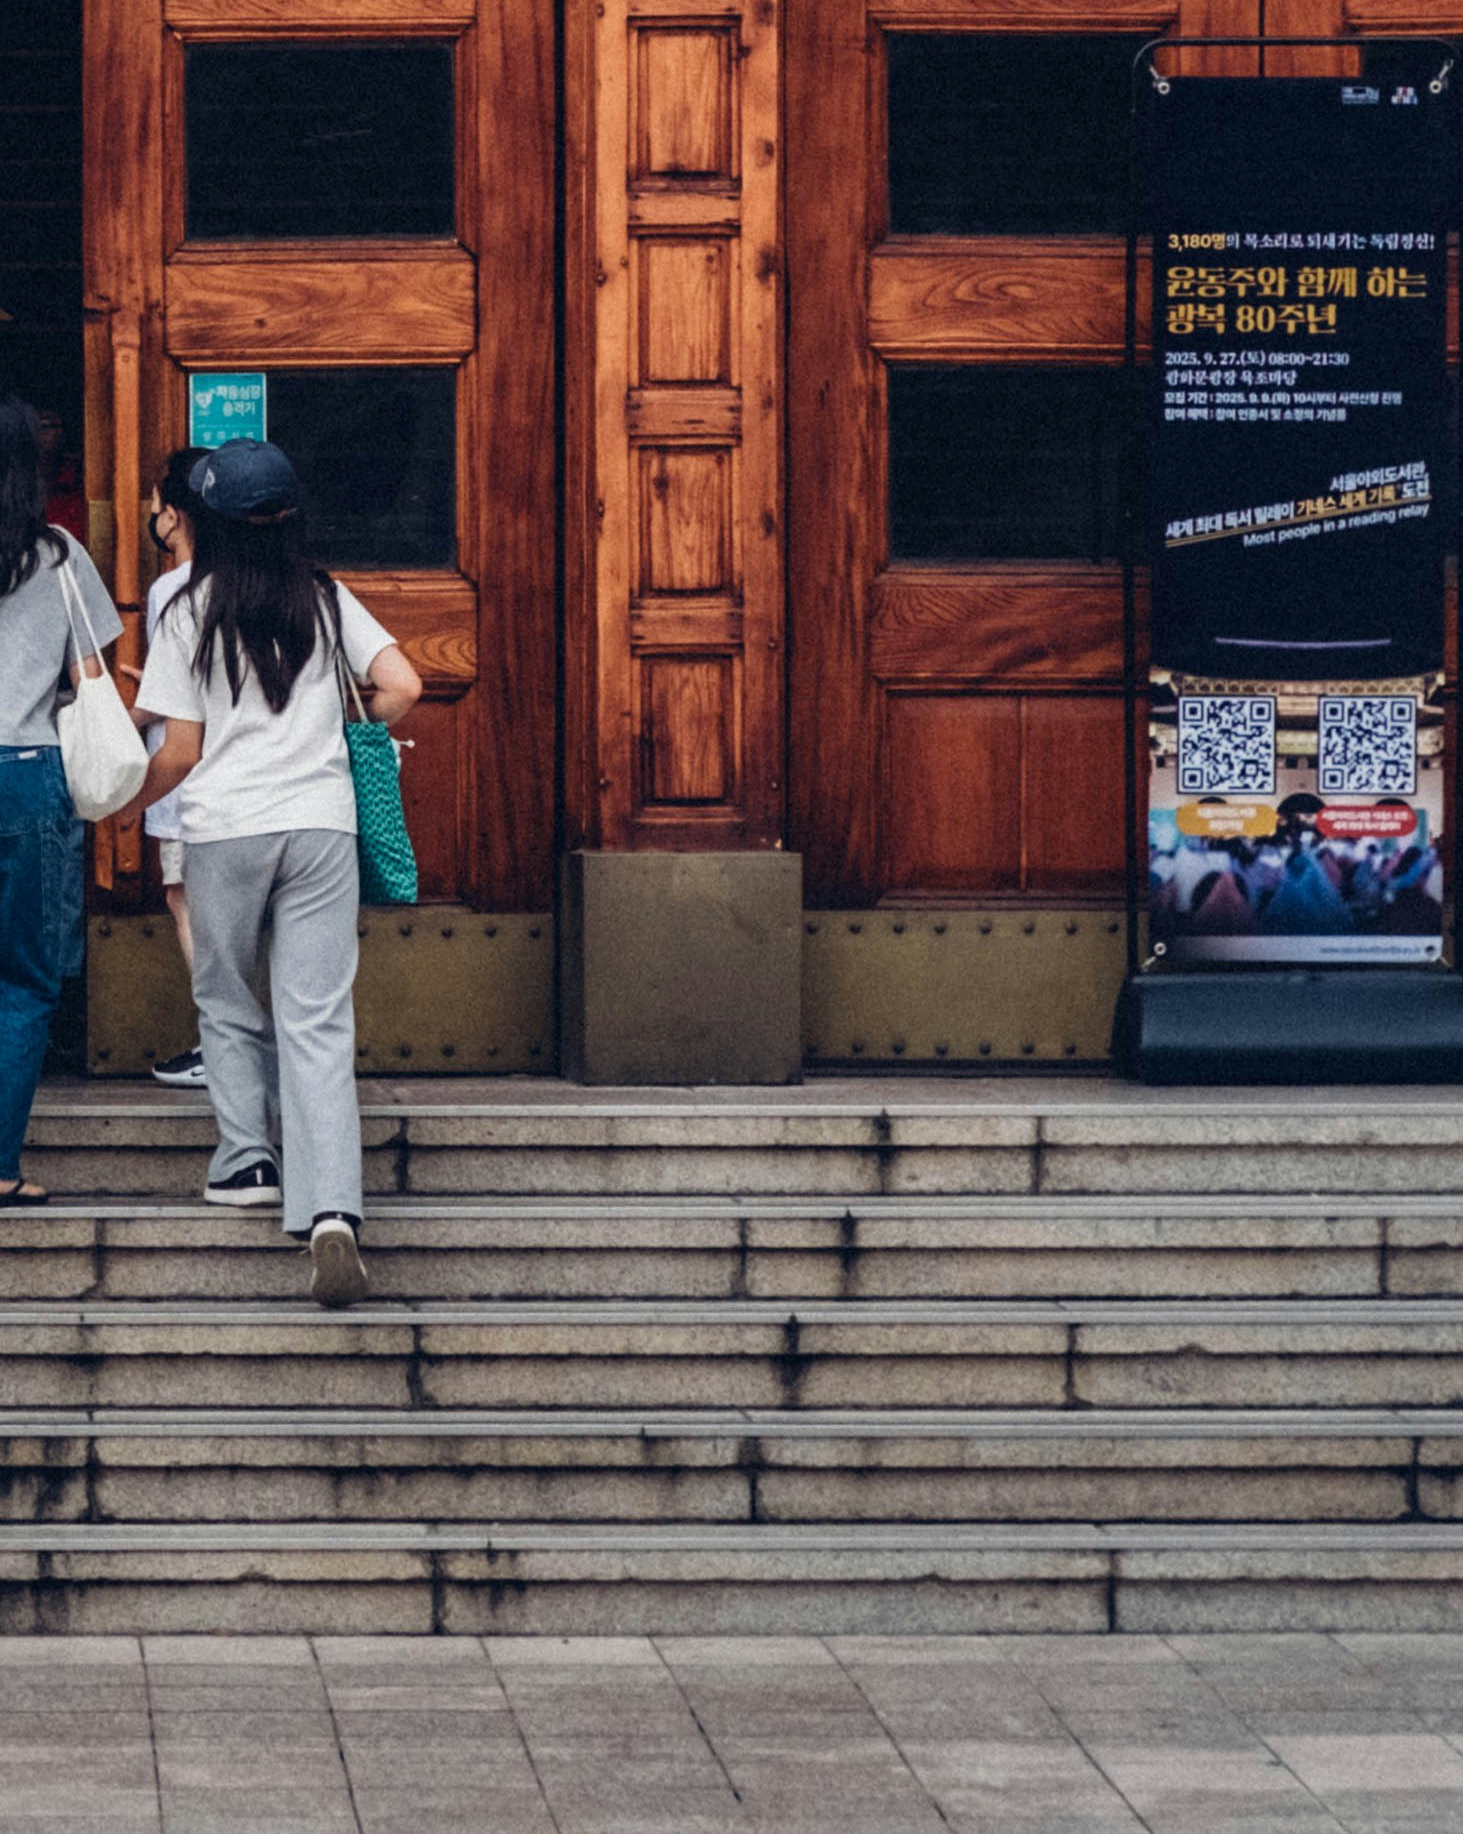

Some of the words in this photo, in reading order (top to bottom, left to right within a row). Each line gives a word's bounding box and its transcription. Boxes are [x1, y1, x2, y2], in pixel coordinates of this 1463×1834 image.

[1168, 232, 1240, 252] 3,180명의
[1307, 232, 1368, 251] 되새기는
[1370, 232, 1435, 251] 독립정신!
[1167, 266, 1289, 298] 윤동주와
[1297, 266, 1358, 298] 함께
[1367, 266, 1427, 298] 하는
[1167, 303, 1225, 334] 광복
[1235, 303, 1338, 335] 80주년
[1165, 351, 1202, 366] 2025.
[1204, 351, 1218, 366] 9.
[1268, 351, 1351, 366] 08:00~21:30
[1297, 495, 1337, 516] 기네스
[1243, 530, 1276, 547] Most
[1278, 523, 1321, 544] people
[1323, 519, 1335, 532] in
[1337, 519, 1346, 529] a
[1348, 508, 1396, 528] reading
[1398, 504, 1430, 519] relay
